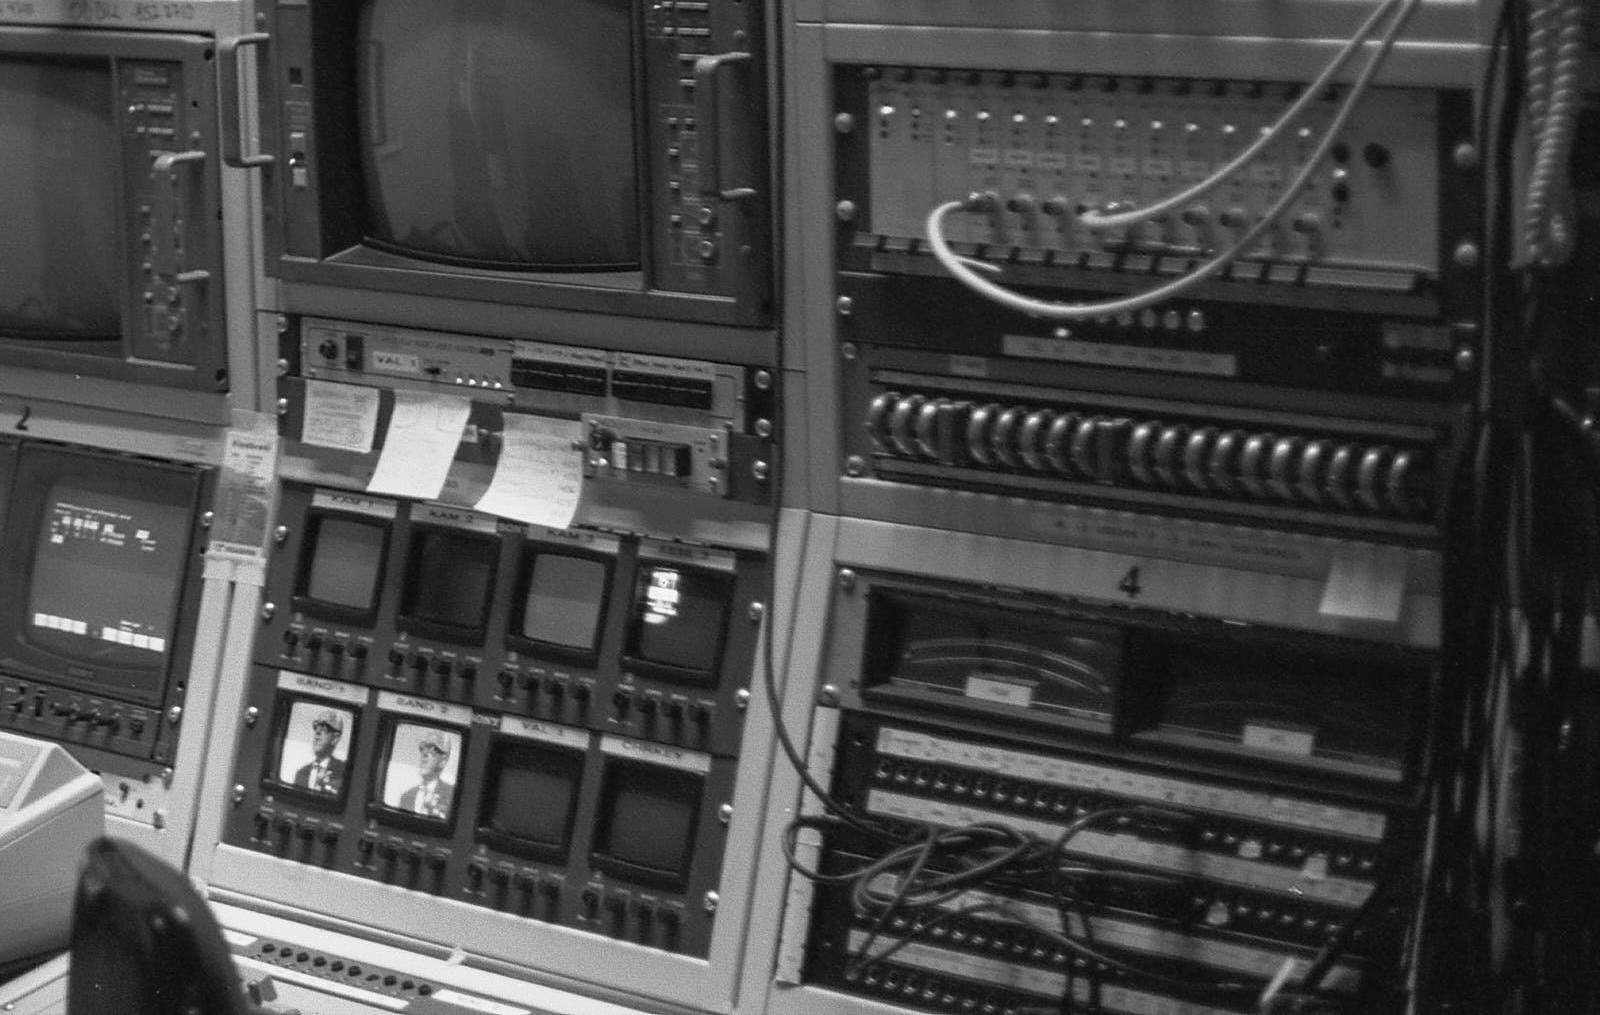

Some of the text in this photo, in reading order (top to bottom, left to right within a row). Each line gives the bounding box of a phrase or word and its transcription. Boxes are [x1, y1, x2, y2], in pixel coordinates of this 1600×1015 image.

[15, 406, 32, 432] 2
[429, 509, 460, 521] KAM
[547, 528, 580, 539] KAM
[1117, 565, 1142, 599] 4
